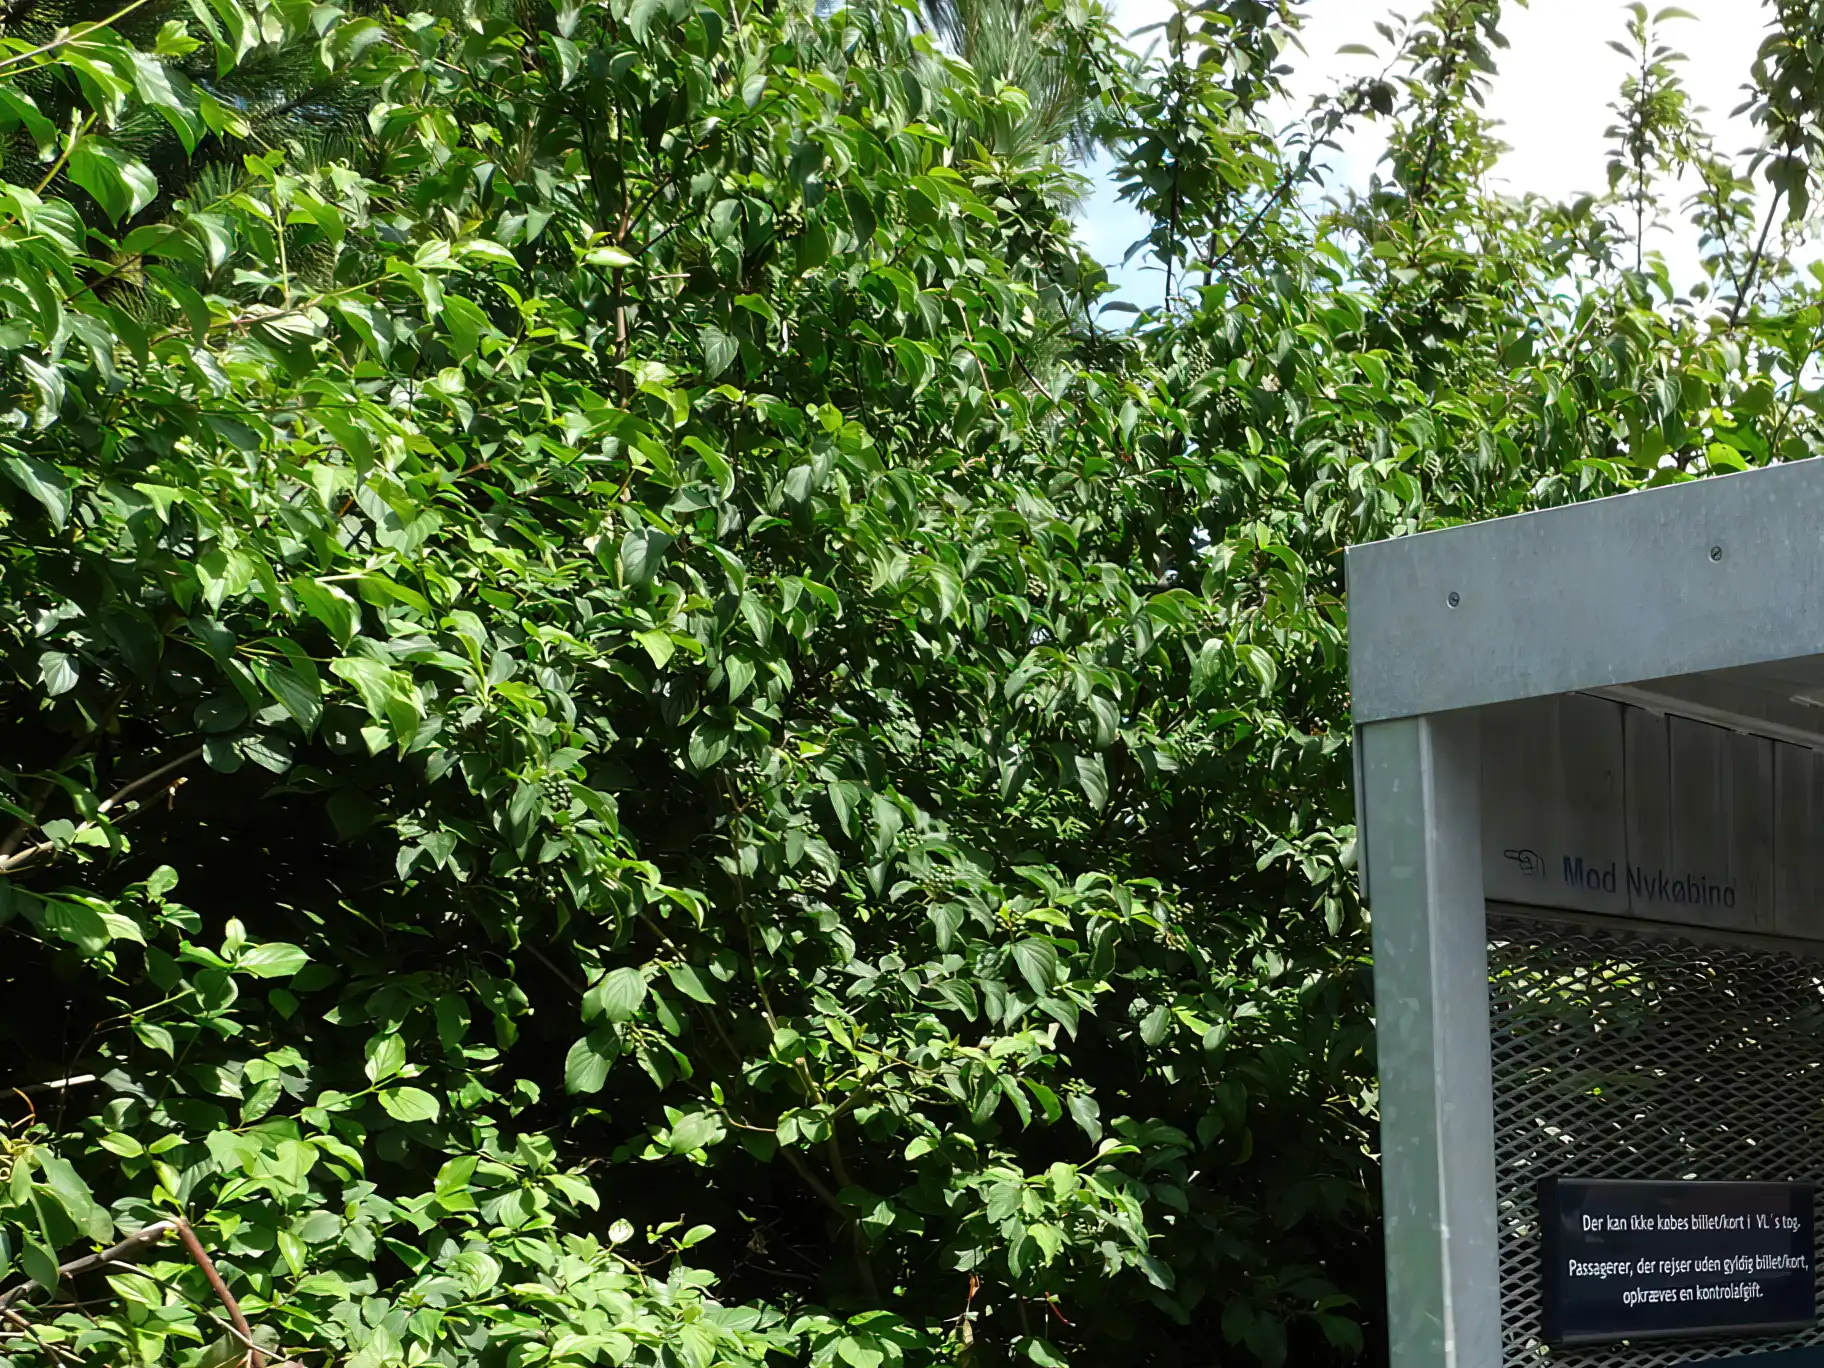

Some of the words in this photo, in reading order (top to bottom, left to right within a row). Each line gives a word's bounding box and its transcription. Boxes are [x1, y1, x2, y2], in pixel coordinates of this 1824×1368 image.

[1562, 855, 1617, 893] Mod
[1582, 1214, 1603, 1231] Der
[1606, 1214, 1627, 1231] kan
[1630, 1214, 1655, 1231] ikke
[1657, 1214, 1689, 1231] købes
[1691, 1214, 1744, 1230] billet/kort
[1568, 1259, 1633, 1279] Passagerer,
[1637, 1257, 1656, 1274] der
[1659, 1257, 1692, 1277] rejser
[1694, 1256, 1721, 1272] uden
[1723, 1254, 1753, 1275] gyldig
[1756, 1253, 1809, 1272] billet/kort,
[1622, 1286, 1677, 1307] opkræves
[1680, 1288, 1694, 1302] en
[1696, 1281, 1764, 1302] kontrolafgift.
